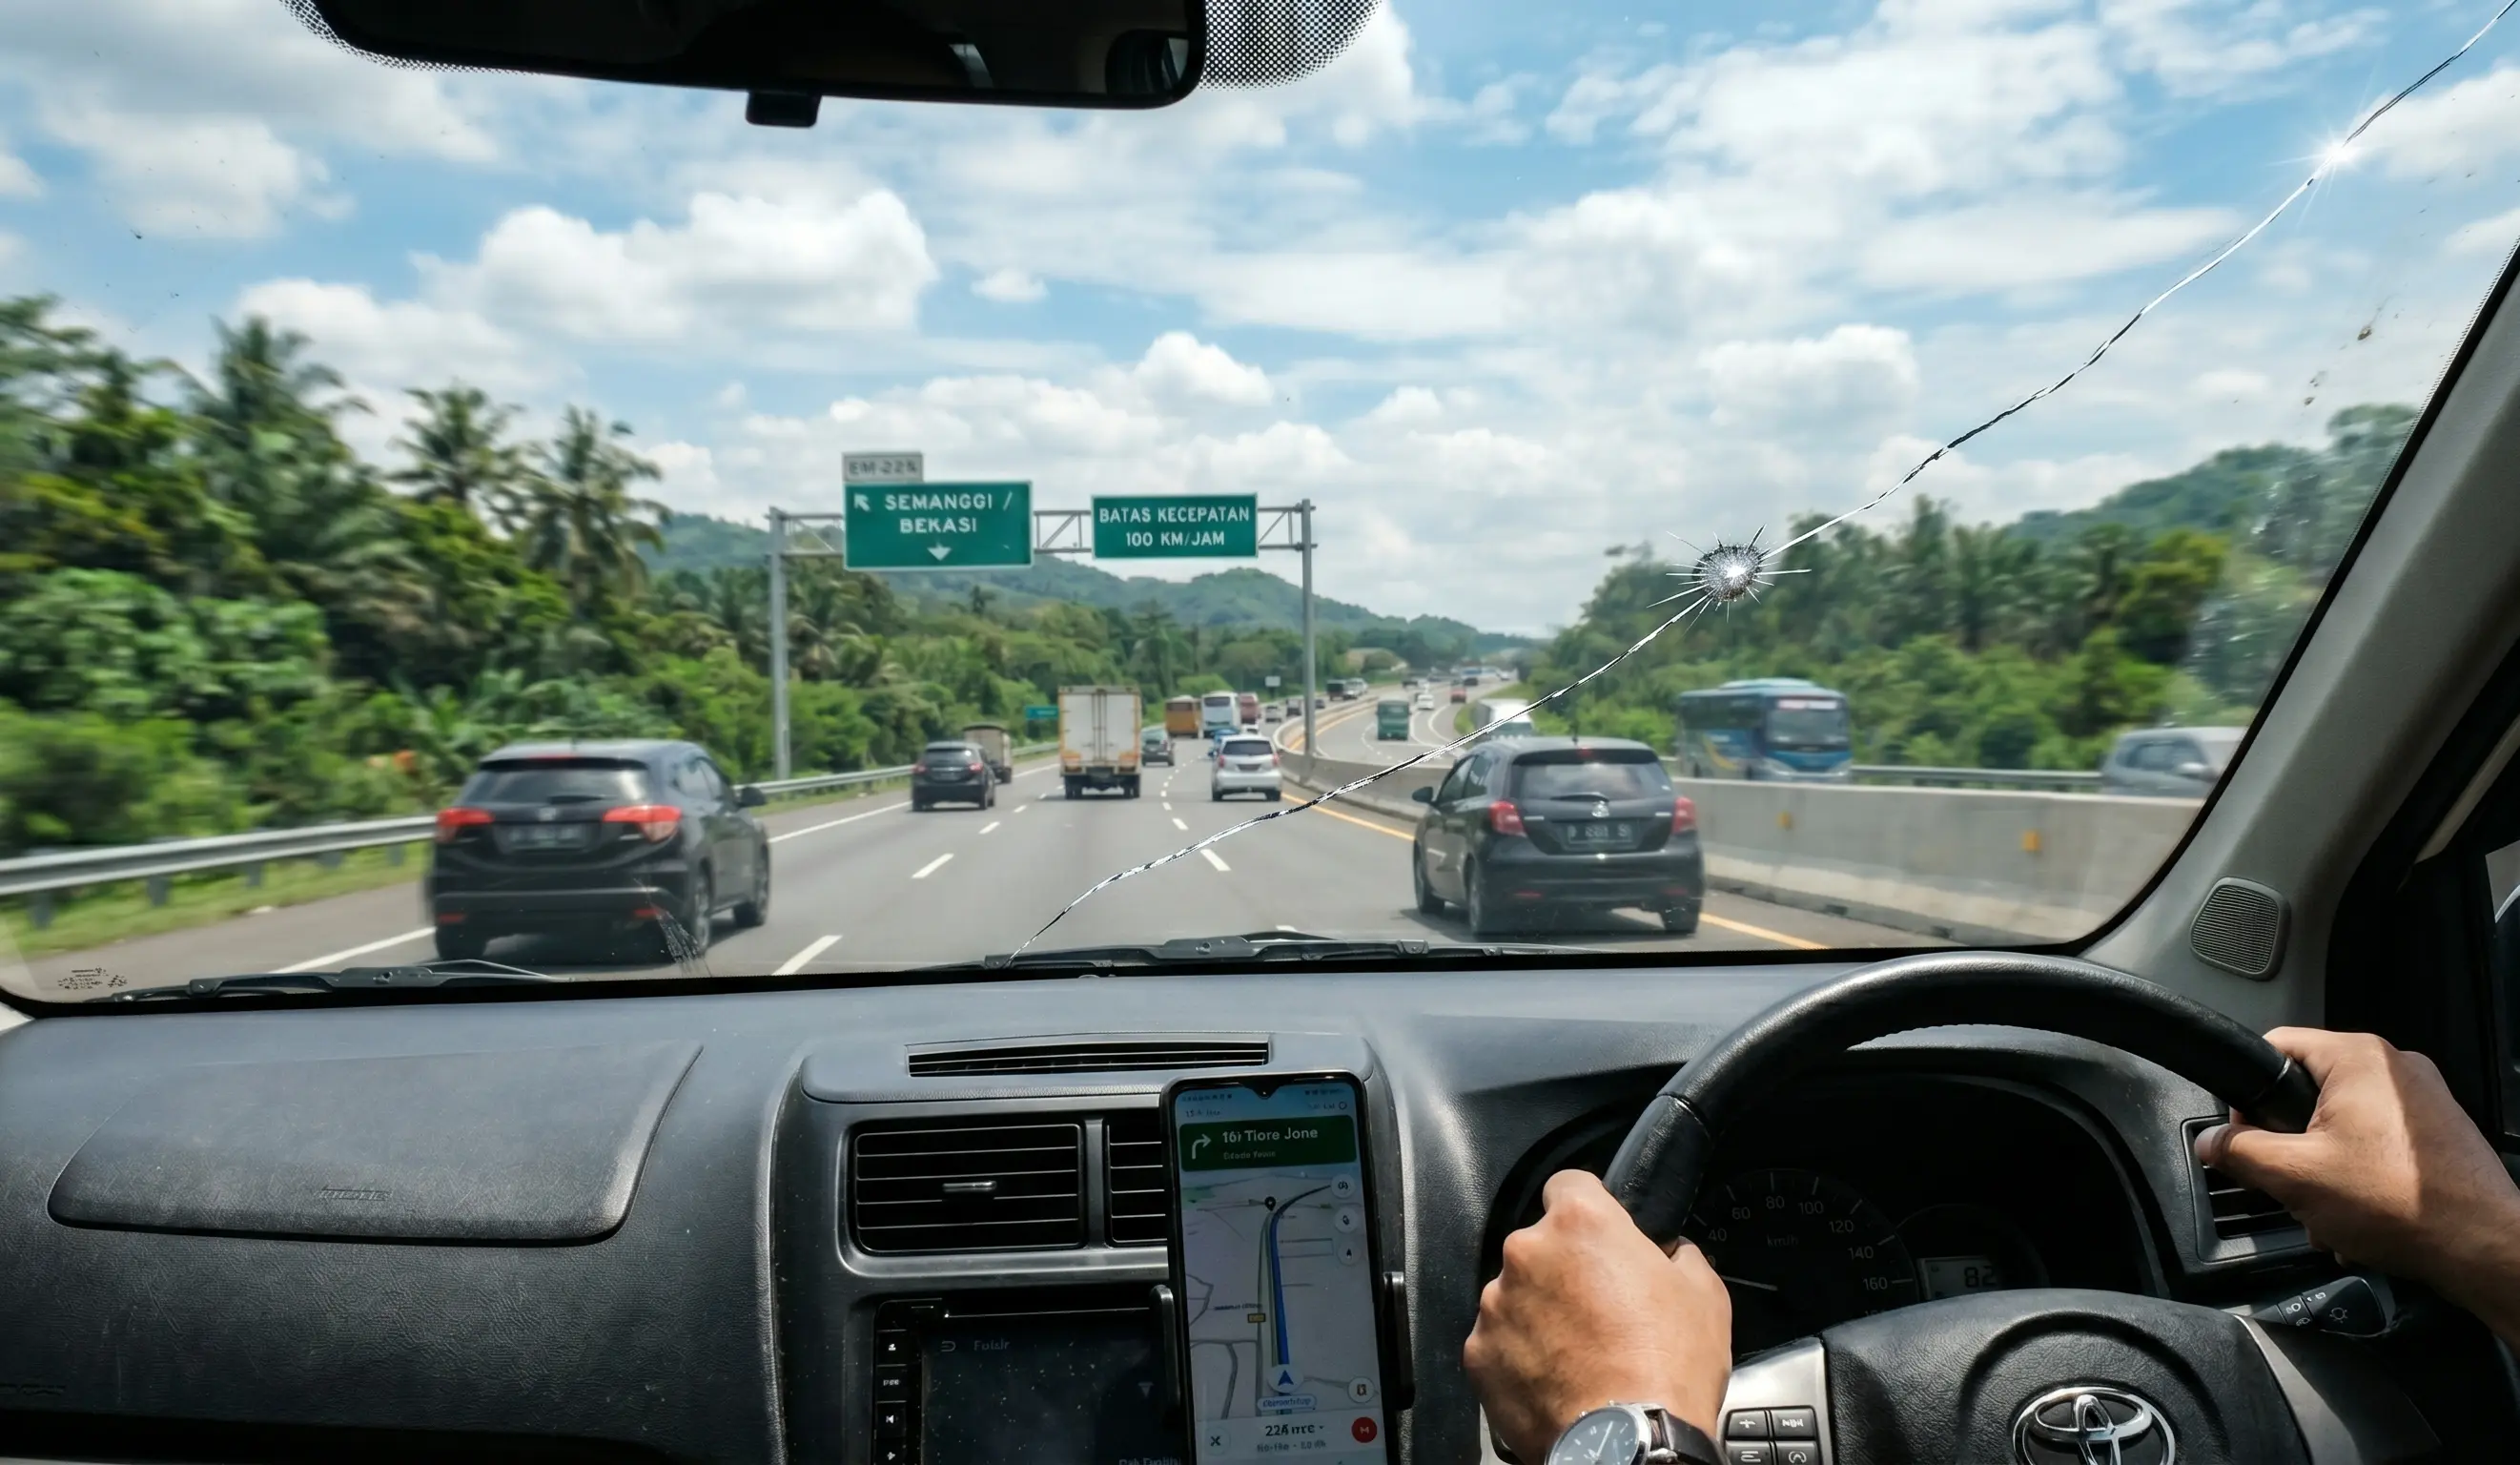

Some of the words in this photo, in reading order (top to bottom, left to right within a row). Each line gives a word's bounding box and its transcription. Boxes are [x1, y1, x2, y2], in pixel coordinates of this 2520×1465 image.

[884, 492, 993, 511] SEMANGGI
[1098, 506, 1152, 524] BATAS
[1157, 506, 1250, 523] KECEPATAN
[899, 517, 977, 534] BEKASI
[1125, 531, 1154, 547] 100
[1159, 530, 1225, 547] KM/JAM
[1283, 1126, 1319, 1141] Jone
[1765, 1195, 1786, 1210] 80
[1797, 1200, 1825, 1215] 100
[1731, 1206, 1752, 1221] 60
[1829, 1219, 1854, 1234] 120
[1707, 1228, 1728, 1243] 40
[1847, 1246, 1875, 1261] 140
[1862, 1276, 1889, 1291] 160
[1963, 1266, 1998, 1288] 82
